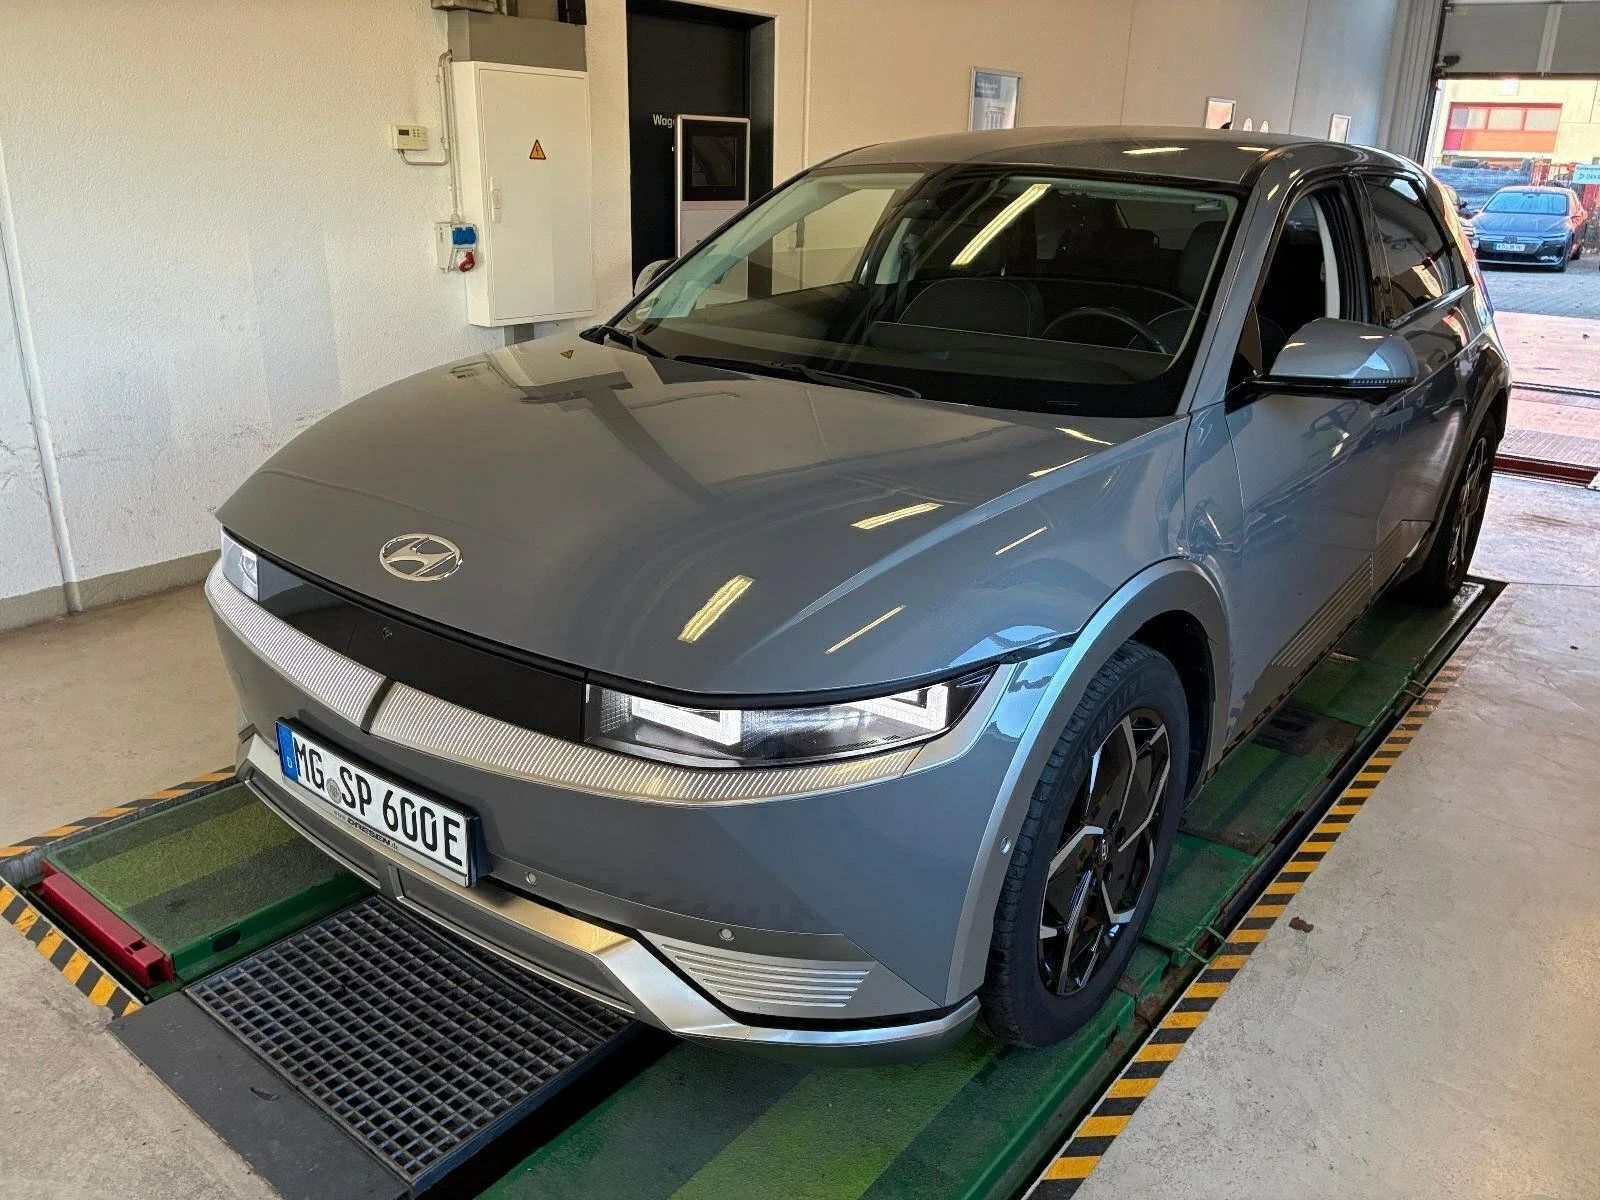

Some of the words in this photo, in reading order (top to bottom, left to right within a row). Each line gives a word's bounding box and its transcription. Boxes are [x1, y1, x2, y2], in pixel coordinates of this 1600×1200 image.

[286, 756, 293, 769] D
[293, 736, 325, 791] MG
[339, 765, 372, 817] SP
[382, 789, 463, 867] 600E
